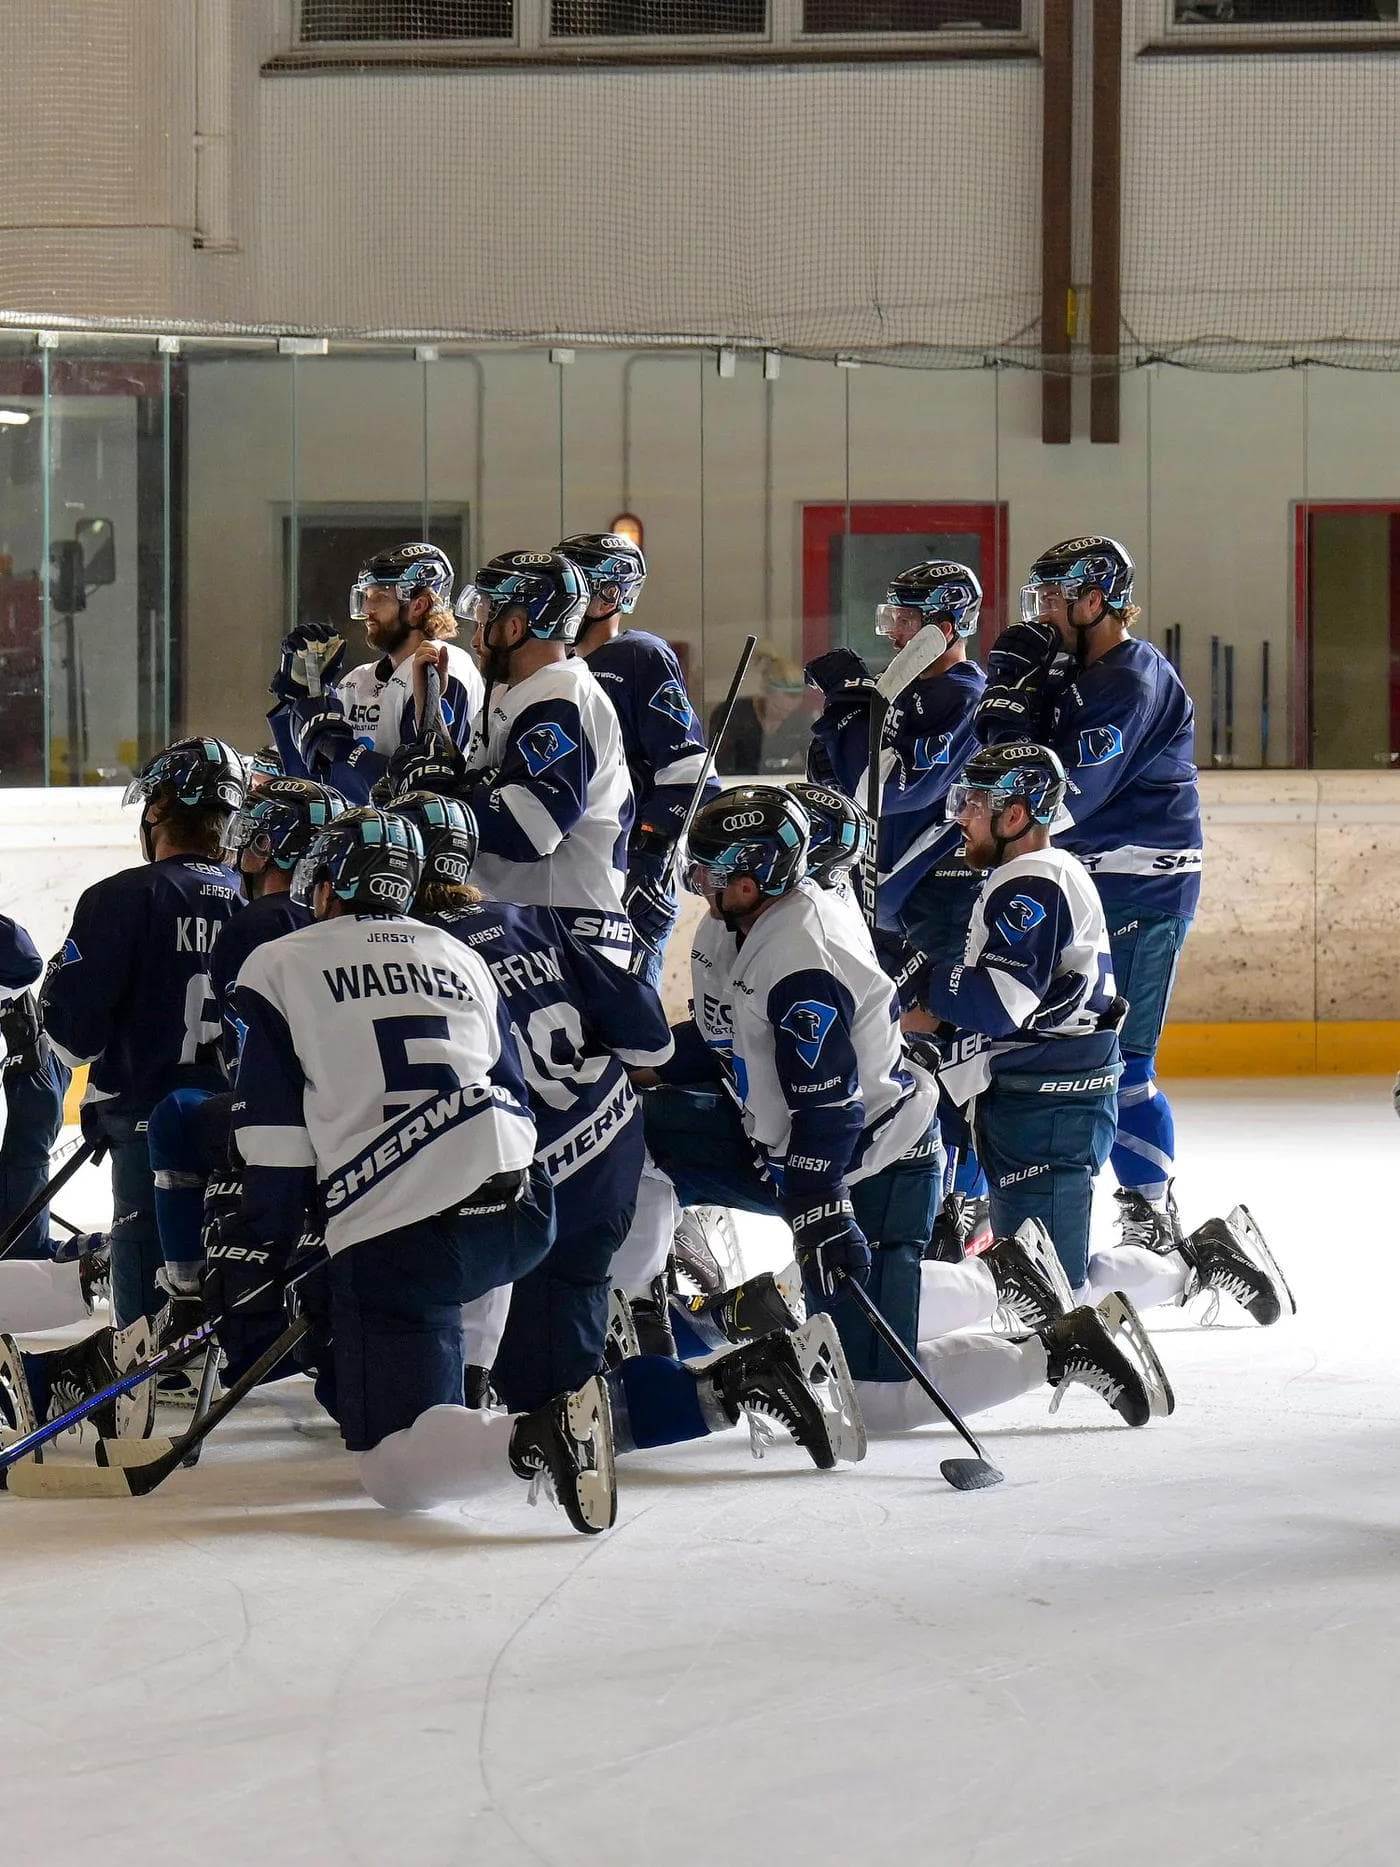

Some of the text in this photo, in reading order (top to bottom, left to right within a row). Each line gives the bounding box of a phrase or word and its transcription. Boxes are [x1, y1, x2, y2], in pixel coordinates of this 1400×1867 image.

[199, 884, 236, 901] JER53Y
[366, 932, 416, 945] JER53Y
[467, 924, 505, 948] JER53Y
[797, 1075, 842, 1093] BAUER
[1038, 1074, 1115, 1093] BAUER
[787, 1153, 831, 1173] JER53Y
[999, 1163, 1051, 1188] BAUER
